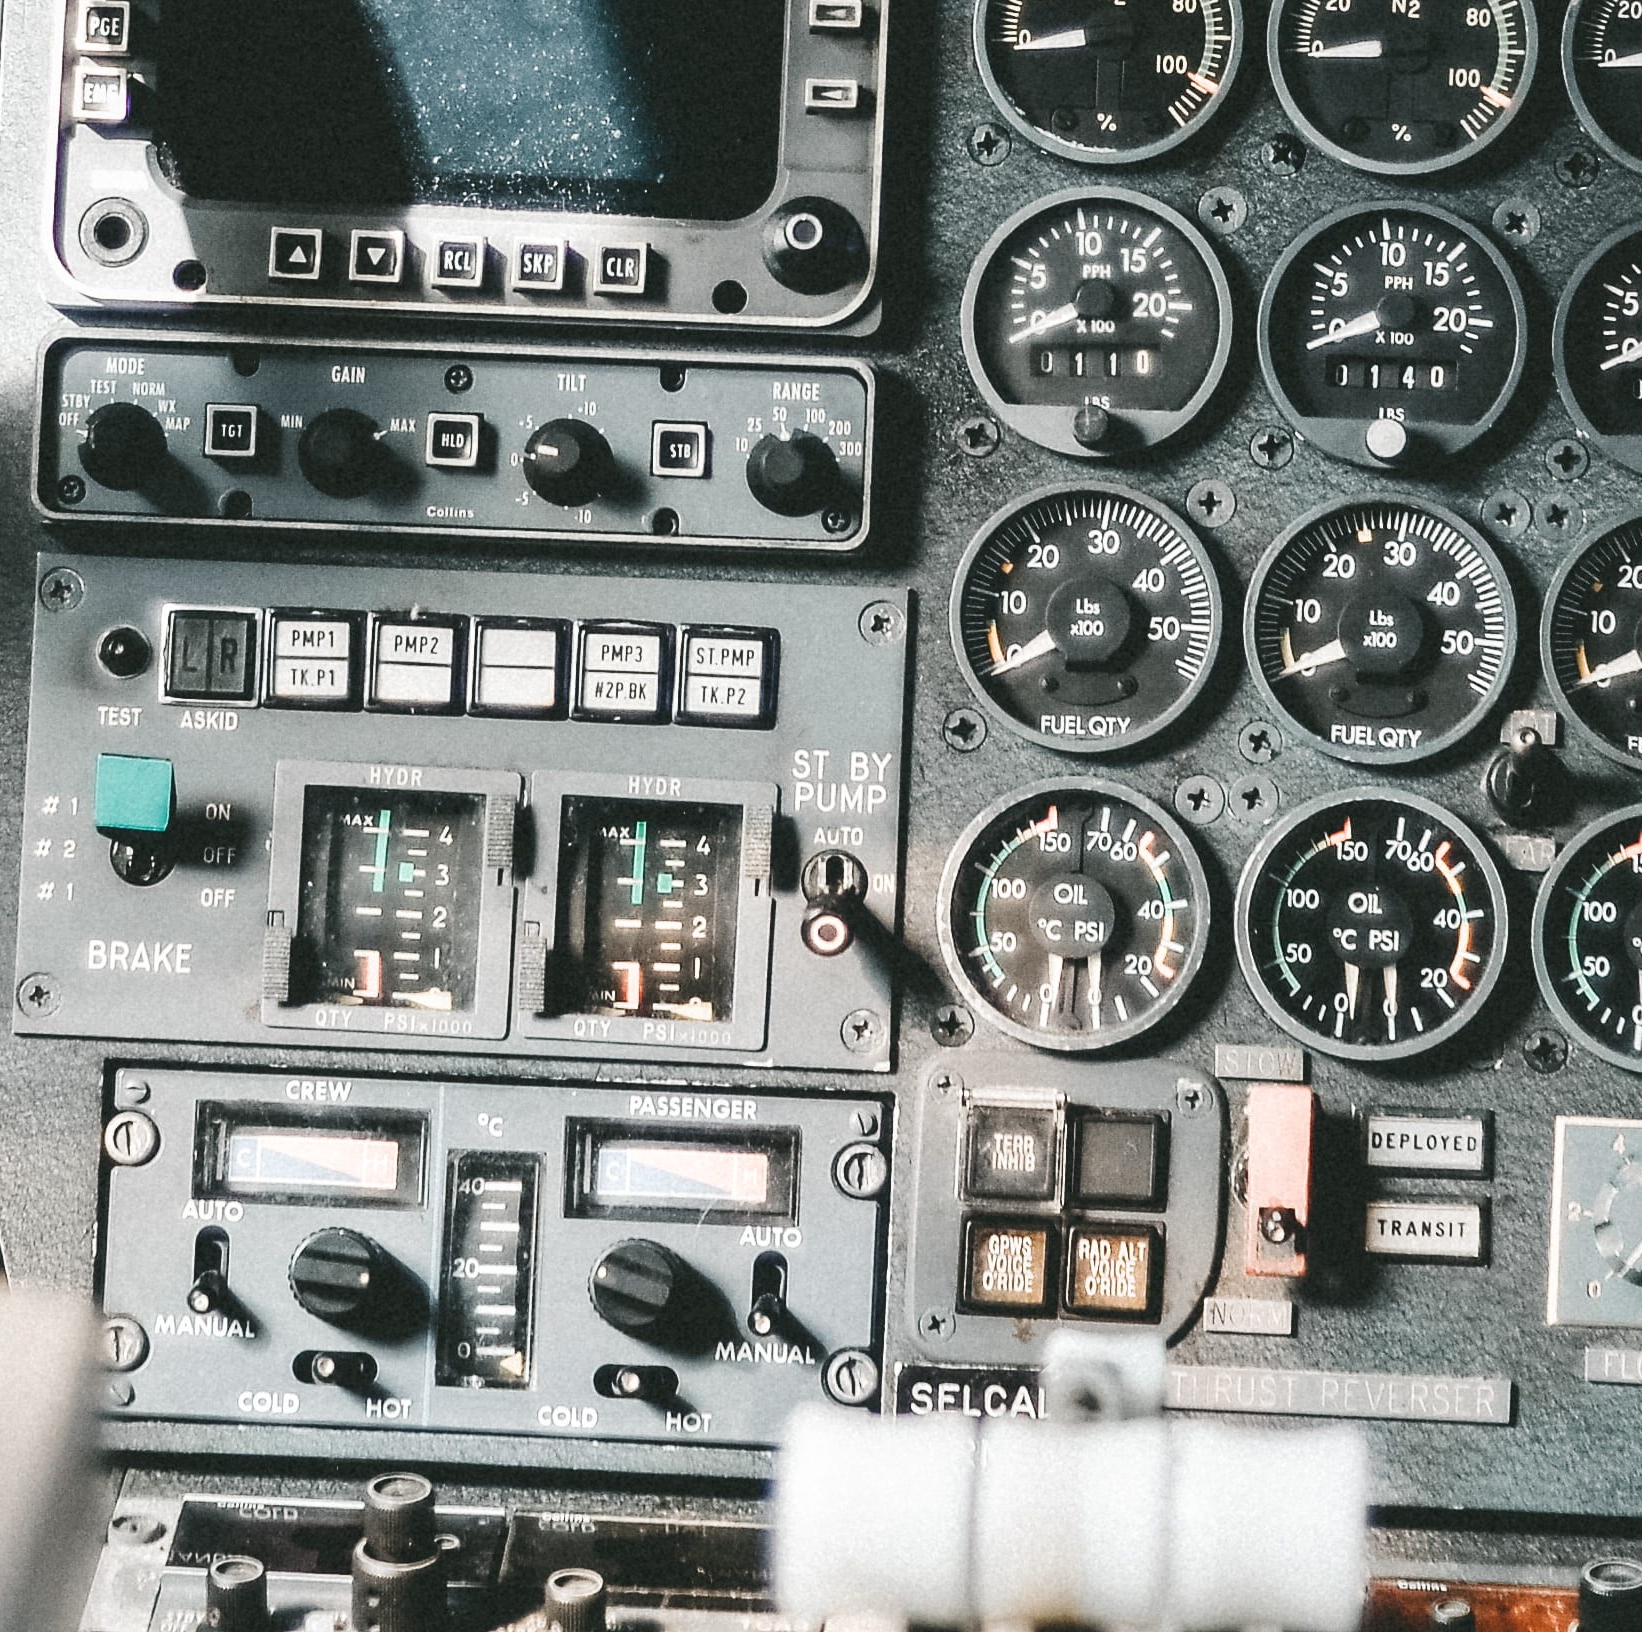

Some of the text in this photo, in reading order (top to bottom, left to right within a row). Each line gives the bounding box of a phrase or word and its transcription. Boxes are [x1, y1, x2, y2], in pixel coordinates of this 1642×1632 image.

[90, 15, 120, 37] PGE
[444, 250, 471, 272] RCL
[524, 251, 553, 274] SKP
[606, 255, 635, 277] CLR
[1082, 264, 1111, 279] PPH
[106, 358, 144, 375] MODE
[331, 366, 365, 383] GAIN
[558, 374, 585, 392] TILT
[772, 383, 820, 400] RANGE
[221, 422, 243, 437] TGT
[441, 432, 465, 449] HLD
[669, 443, 692, 459] STB
[291, 629, 334, 647] PMP1
[394, 635, 439, 654] PMP2
[601, 645, 643, 662] PMP3
[98, 707, 142, 725] TEST
[181, 712, 238, 730] ASKID
[1041, 715, 1131, 736] FUEL QTY
[793, 750, 891, 781] ST BY
[795, 783, 886, 813] PUMP
[814, 827, 864, 845] AUTO
[1054, 884, 1088, 905] OIL
[1074, 921, 1104, 942] PSI
[88, 940, 192, 973] BRAKE
[286, 1081, 352, 1102] CREW
[630, 1096, 757, 1120] PASSENGER
[994, 1135, 1035, 1152] TERR
[1371, 1130, 1478, 1153] DEPLOYED
[992, 1153, 1036, 1172] INHIB
[182, 1200, 244, 1222] AUTO
[739, 1226, 802, 1248] AUTO
[1378, 1219, 1469, 1238] TRANSIT
[155, 1316, 255, 1338] MANUAL
[715, 1341, 815, 1364] MANUAL
[238, 1392, 300, 1413] COLD
[366, 1398, 412, 1419] HOT
[537, 1406, 598, 1429] COLD
[666, 1411, 712, 1432] HOT
